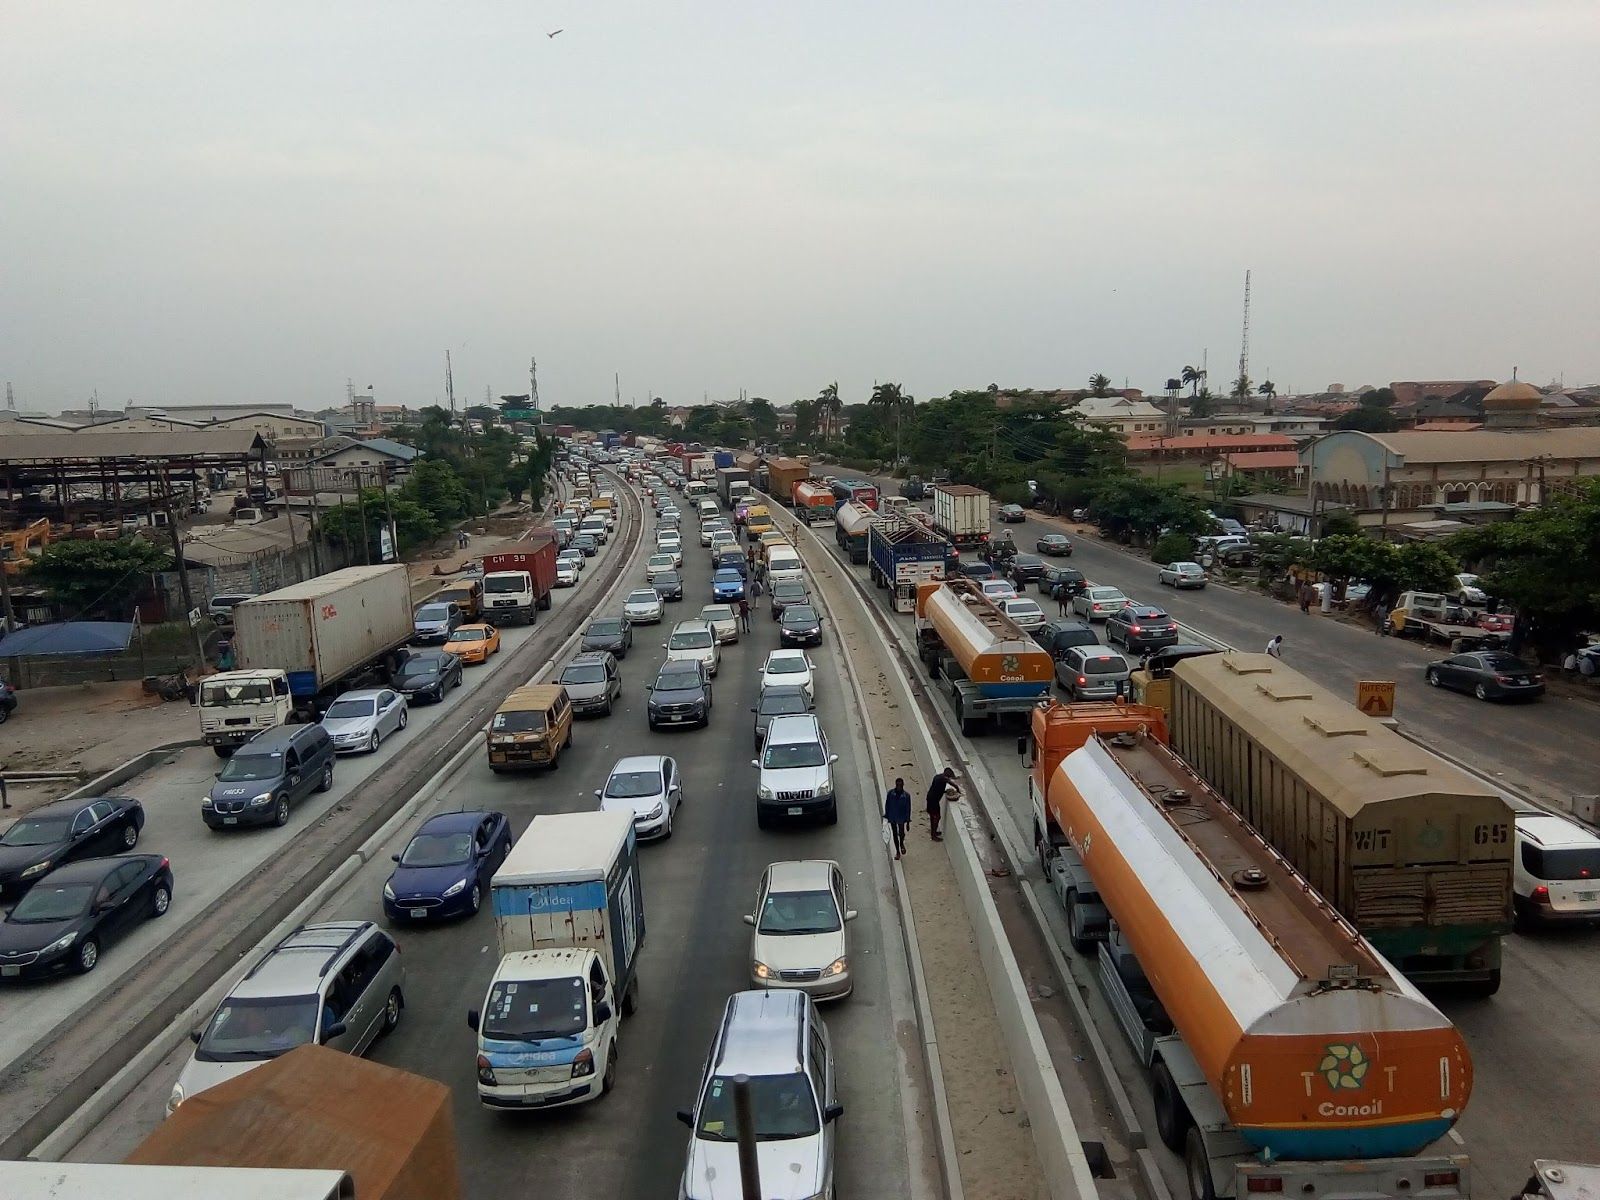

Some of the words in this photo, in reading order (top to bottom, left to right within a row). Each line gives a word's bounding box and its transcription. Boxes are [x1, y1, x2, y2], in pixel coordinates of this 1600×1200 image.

[492, 555, 505, 563] CH
[513, 554, 526, 562] 39
[982, 667, 991, 676] T
[1033, 664, 1041, 673] T
[1000, 674, 1025, 682] Conoil
[1474, 824, 1508, 845] 65
[1301, 1071, 1315, 1097] T
[1383, 1066, 1397, 1092] T
[1318, 1099, 1383, 1117] Conoil
